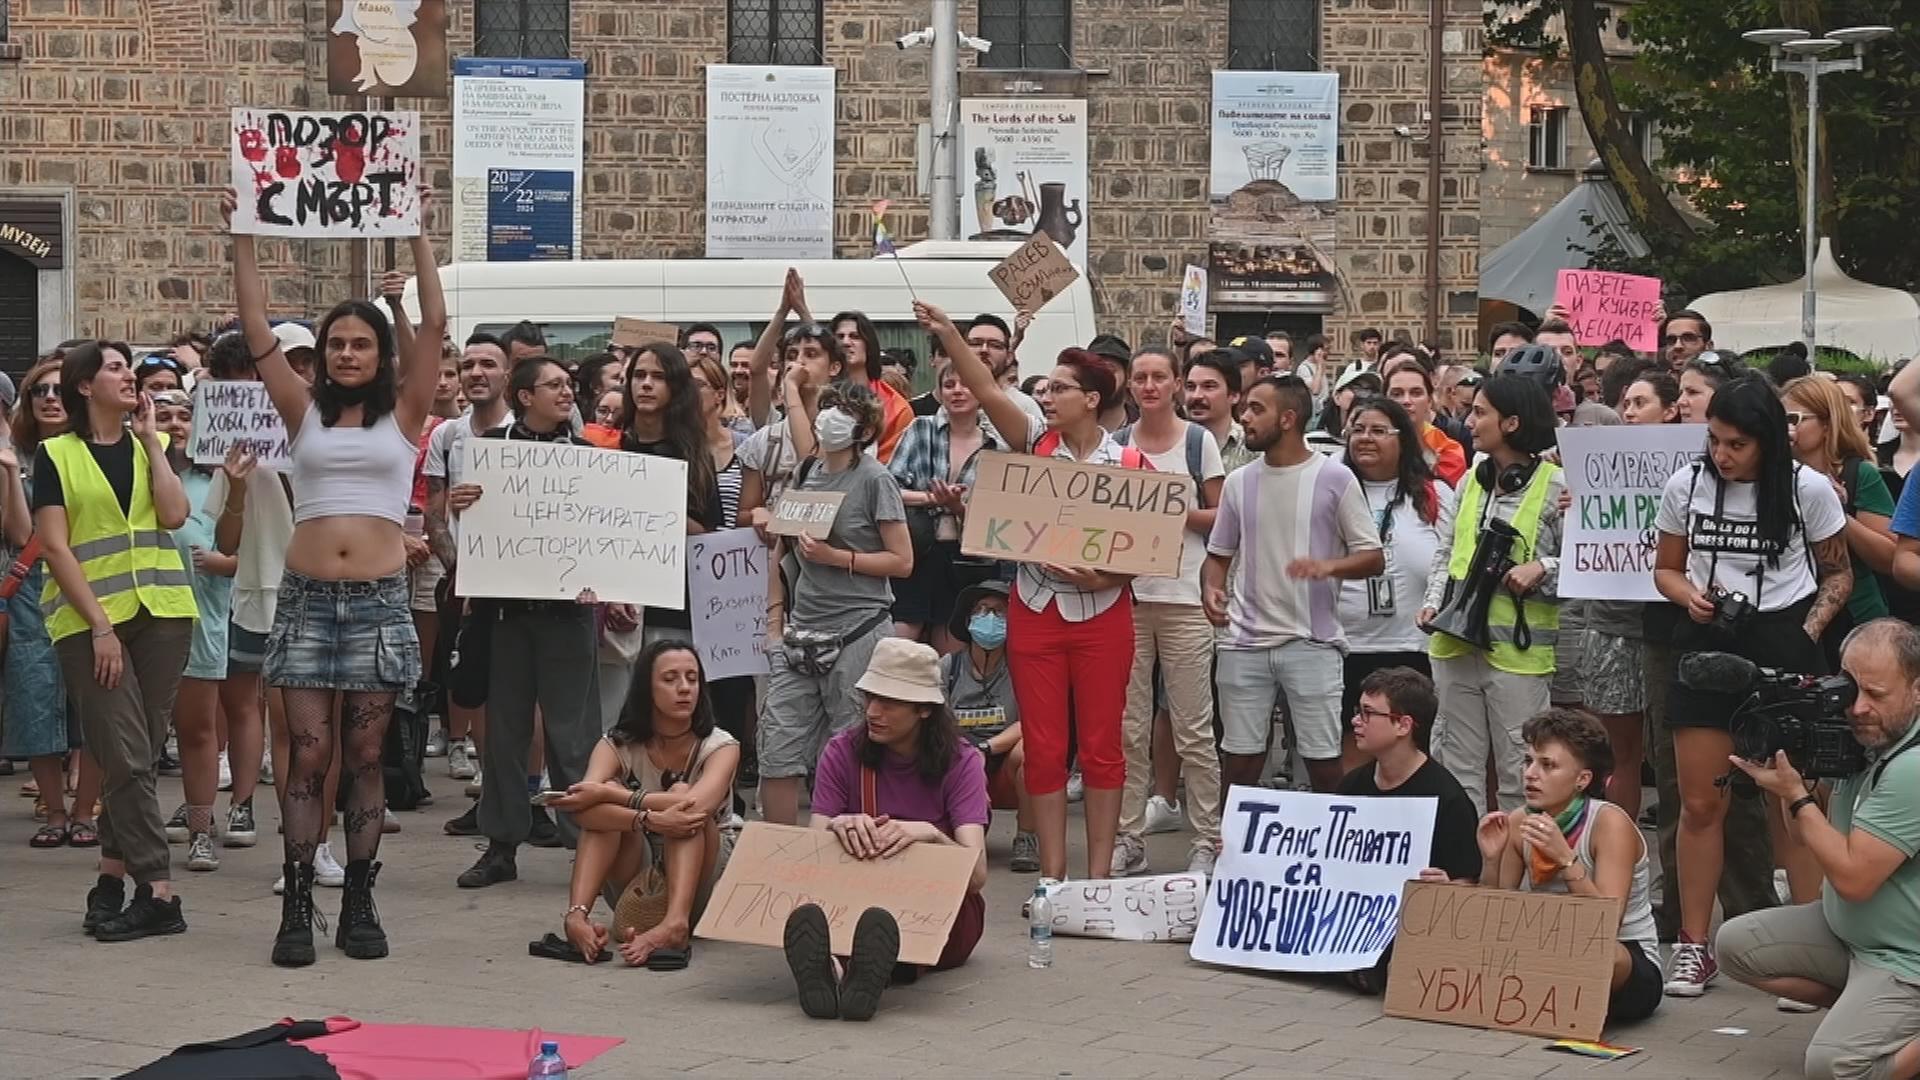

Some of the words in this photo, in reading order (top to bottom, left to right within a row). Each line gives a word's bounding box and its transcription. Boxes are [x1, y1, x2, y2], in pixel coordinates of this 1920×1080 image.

[720, 91, 771, 103] ПОСТЕРНА
[773, 92, 821, 104] ИЗЛОЖБА
[971, 113, 990, 124] The
[993, 113, 1021, 124] Lords
[1024, 113, 1036, 124] of
[1037, 113, 1055, 124] the
[1057, 113, 1077, 124] Salt
[266, 113, 385, 169] ПОЗОР
[1260, 130, 1280, 138] 4350
[490, 170, 509, 184] 20
[516, 189, 534, 202] 22
[711, 201, 776, 211] НЕВИДИМИТЕ
[812, 202, 825, 210] НА
[0, 223, 51, 258] МУЗЕЙ
[996, 241, 1050, 288] РАДЕВ
[1565, 272, 1634, 296] ПАЗЕТЕ
[1572, 295, 1583, 312] И
[1572, 319, 1643, 342] ДЕЦАТА
[473, 447, 490, 471] И
[500, 446, 648, 480] БИОЛОГИЯТА
[1584, 451, 1707, 490] ОМРАЗА
[502, 475, 530, 496] ЛИ
[542, 475, 582, 500] ЩЕ
[1001, 463, 1186, 516] ПЛОВДИВ
[513, 501, 679, 532] ЦЕНЗУРИРАТЕ?
[1056, 504, 1081, 526] Е
[1580, 494, 1628, 531] КЪМ
[1633, 494, 1662, 531] РА
[1735, 525, 1750, 535] DO
[467, 534, 485, 558] И
[1726, 537, 1749, 549] FOR
[711, 545, 767, 580] ОТК
[1575, 543, 1655, 573] БЪЛГАРС
[558, 556, 578, 592] ?
[1284, 861, 1321, 887] СА
[1401, 885, 1610, 959] СИСТЕМАТА
